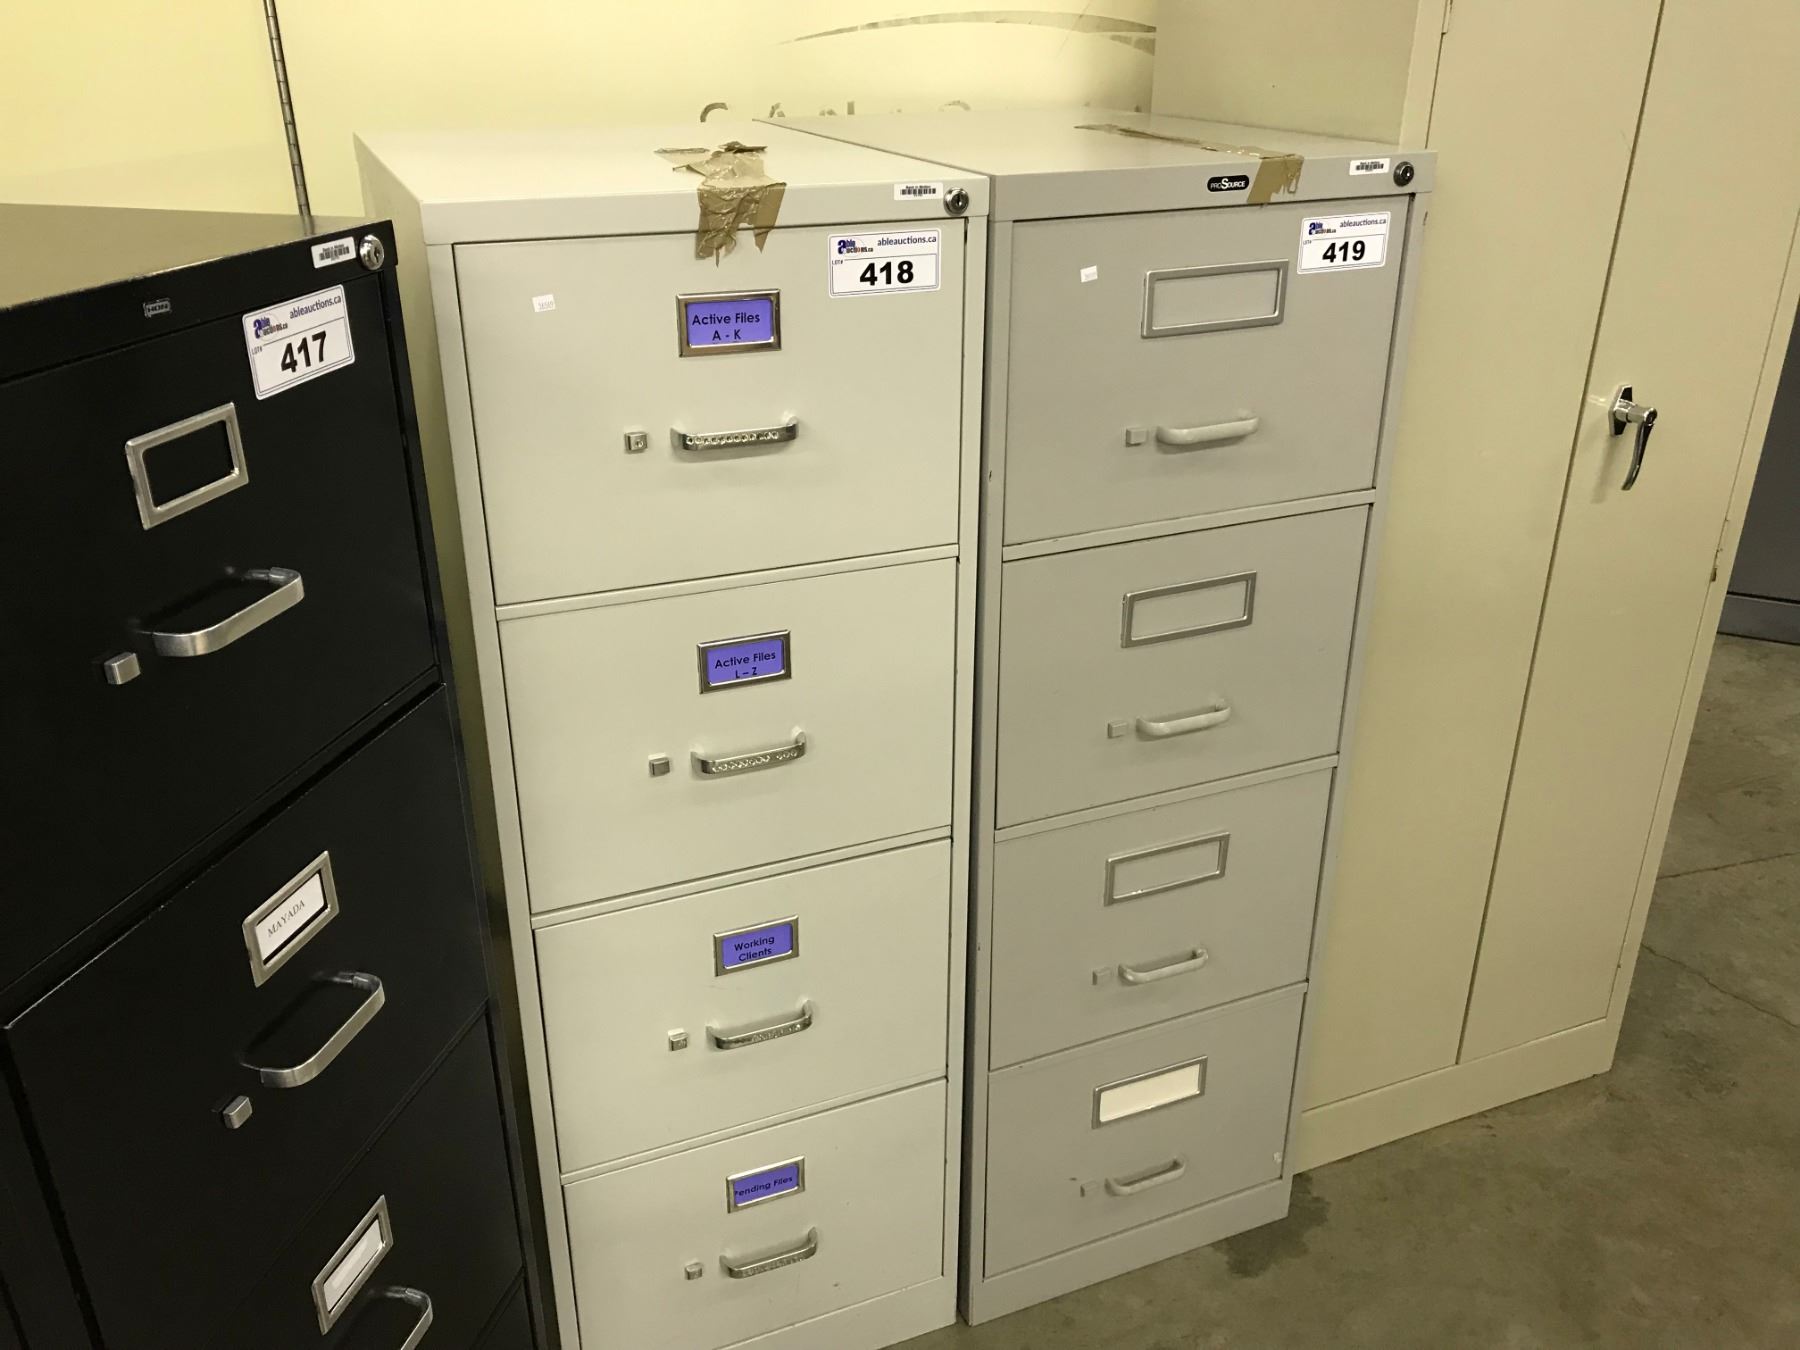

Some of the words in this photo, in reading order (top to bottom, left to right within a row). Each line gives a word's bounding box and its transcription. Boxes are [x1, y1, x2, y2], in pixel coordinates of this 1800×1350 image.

[1340, 219, 1387, 228] ableauctions.ca
[877, 236, 937, 247] ableauctions.ca
[1322, 240, 1365, 263] 419
[860, 260, 914, 286] 418
[289, 295, 342, 319] ableauctions.ca
[692, 313, 731, 326] Active
[735, 312, 760, 324] Files
[712, 330, 722, 341] A
[734, 329, 742, 340] K
[281, 330, 327, 373] 417
[714, 656, 750, 670] Active
[753, 652, 776, 662] Files
[735, 670, 740, 679] L
[751, 667, 757, 676] Z
[267, 900, 306, 938] MAYADA
[734, 936, 775, 951] Working
[738, 948, 772, 962] Clients
[773, 1177, 793, 1187] Files
